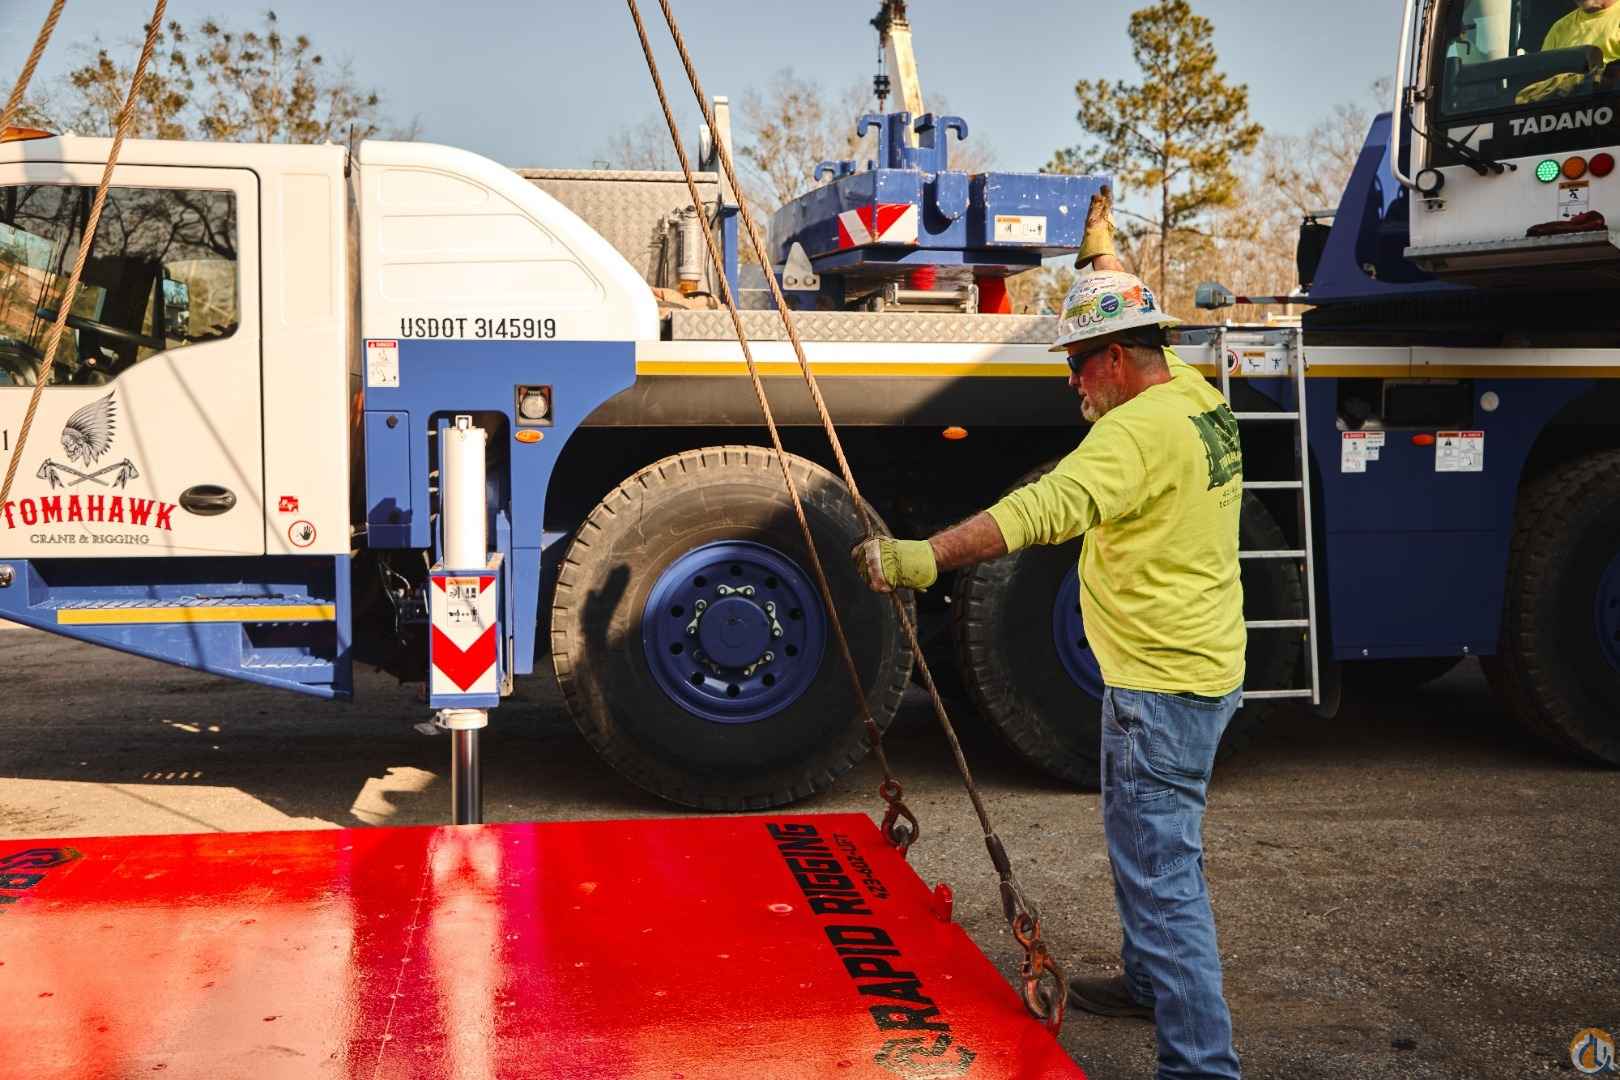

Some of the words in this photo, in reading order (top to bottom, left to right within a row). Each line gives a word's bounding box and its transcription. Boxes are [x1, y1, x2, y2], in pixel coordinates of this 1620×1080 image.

[1509, 107, 1613, 136] TADANO
[401, 318, 468, 338] USDOT
[475, 318, 556, 338] 3145919
[0, 495, 177, 531] TOMAHAWK
[30, 534, 76, 544] CRANE
[79, 534, 89, 544] &
[92, 534, 149, 544] RIGGING
[766, 823, 873, 915] RIGGING
[825, 925, 951, 1032] RAPID
